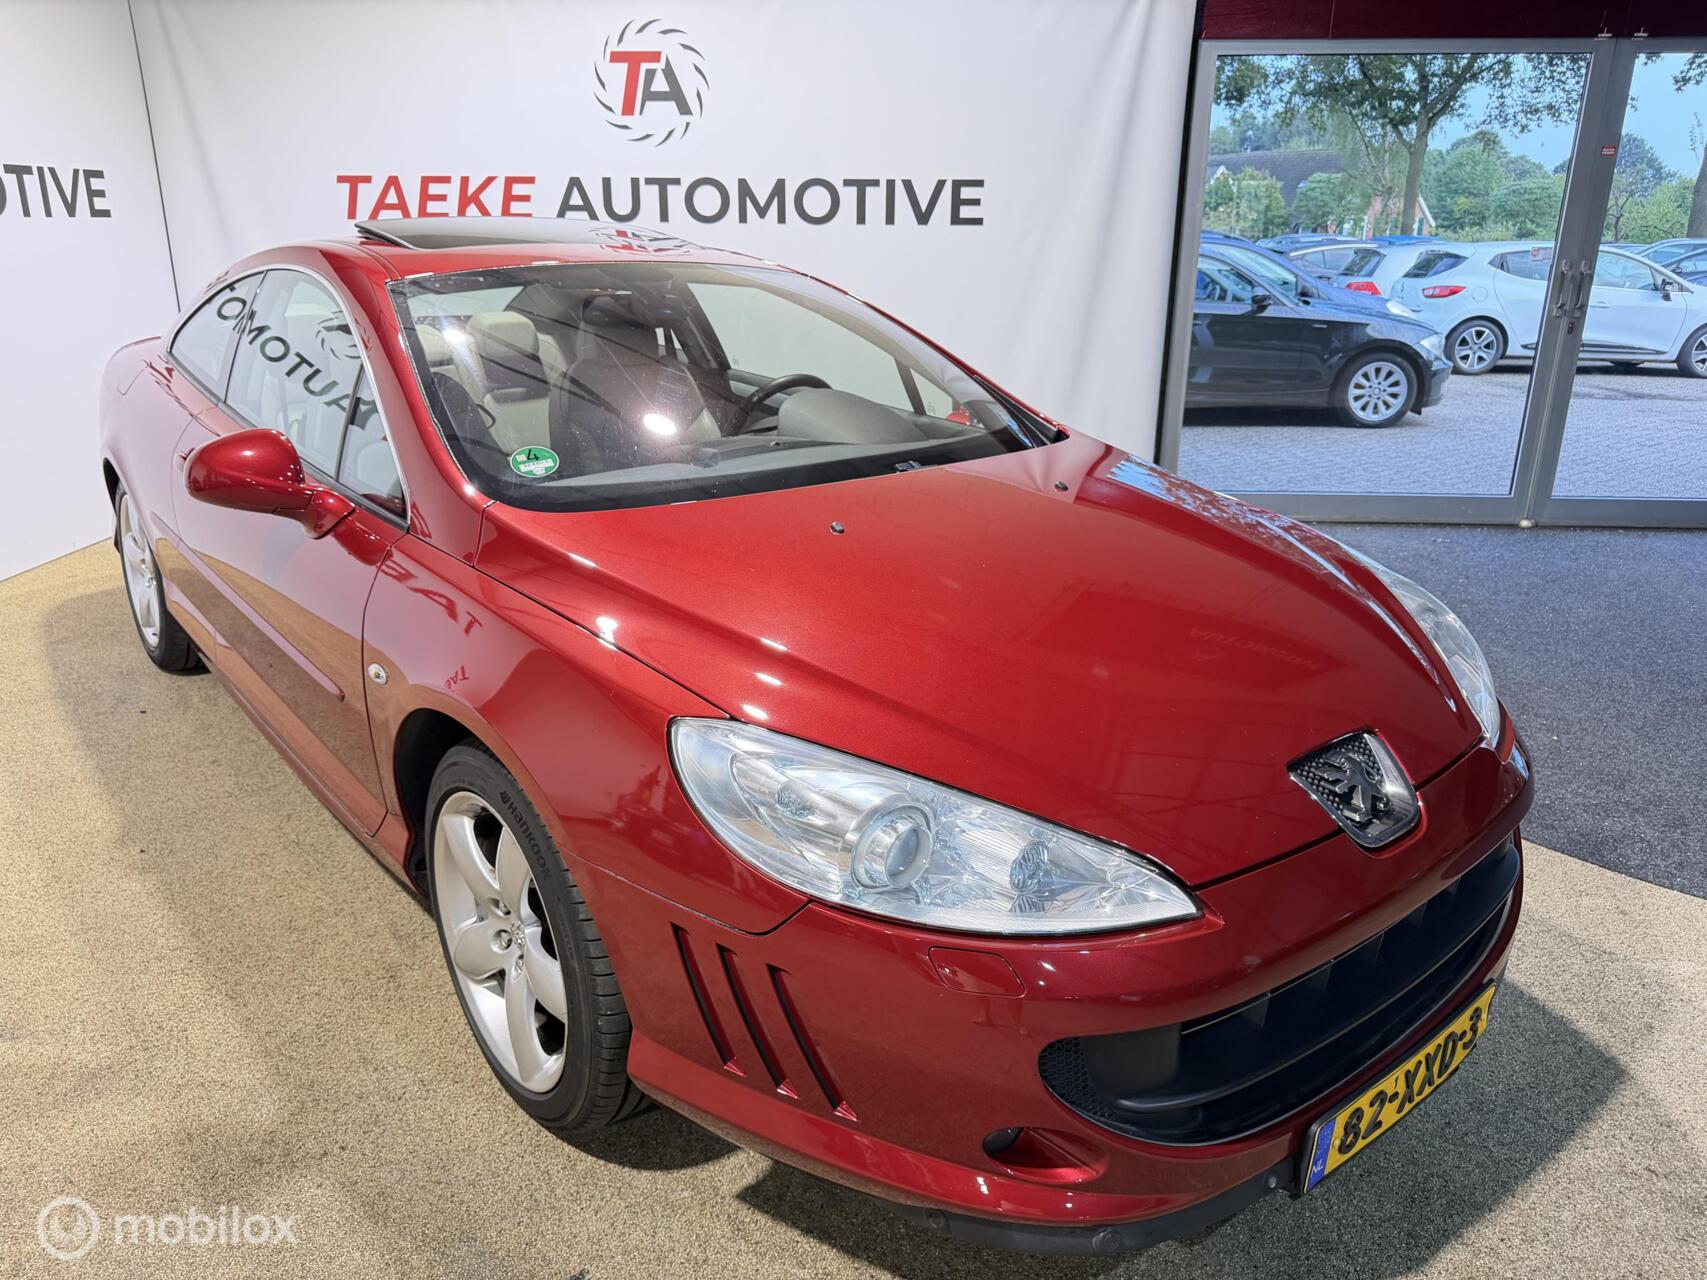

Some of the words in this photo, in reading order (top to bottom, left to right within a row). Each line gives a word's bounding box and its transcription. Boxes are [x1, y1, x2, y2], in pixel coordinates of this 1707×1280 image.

[610, 50, 692, 117] TA
[0, 164, 112, 218] TIVE
[336, 175, 536, 220] TAEKE
[556, 176, 985, 227] AUTOMOTIVE
[1338, 1006, 1482, 1155] 82-XXD-3
[1311, 1161, 1324, 1178] NL
